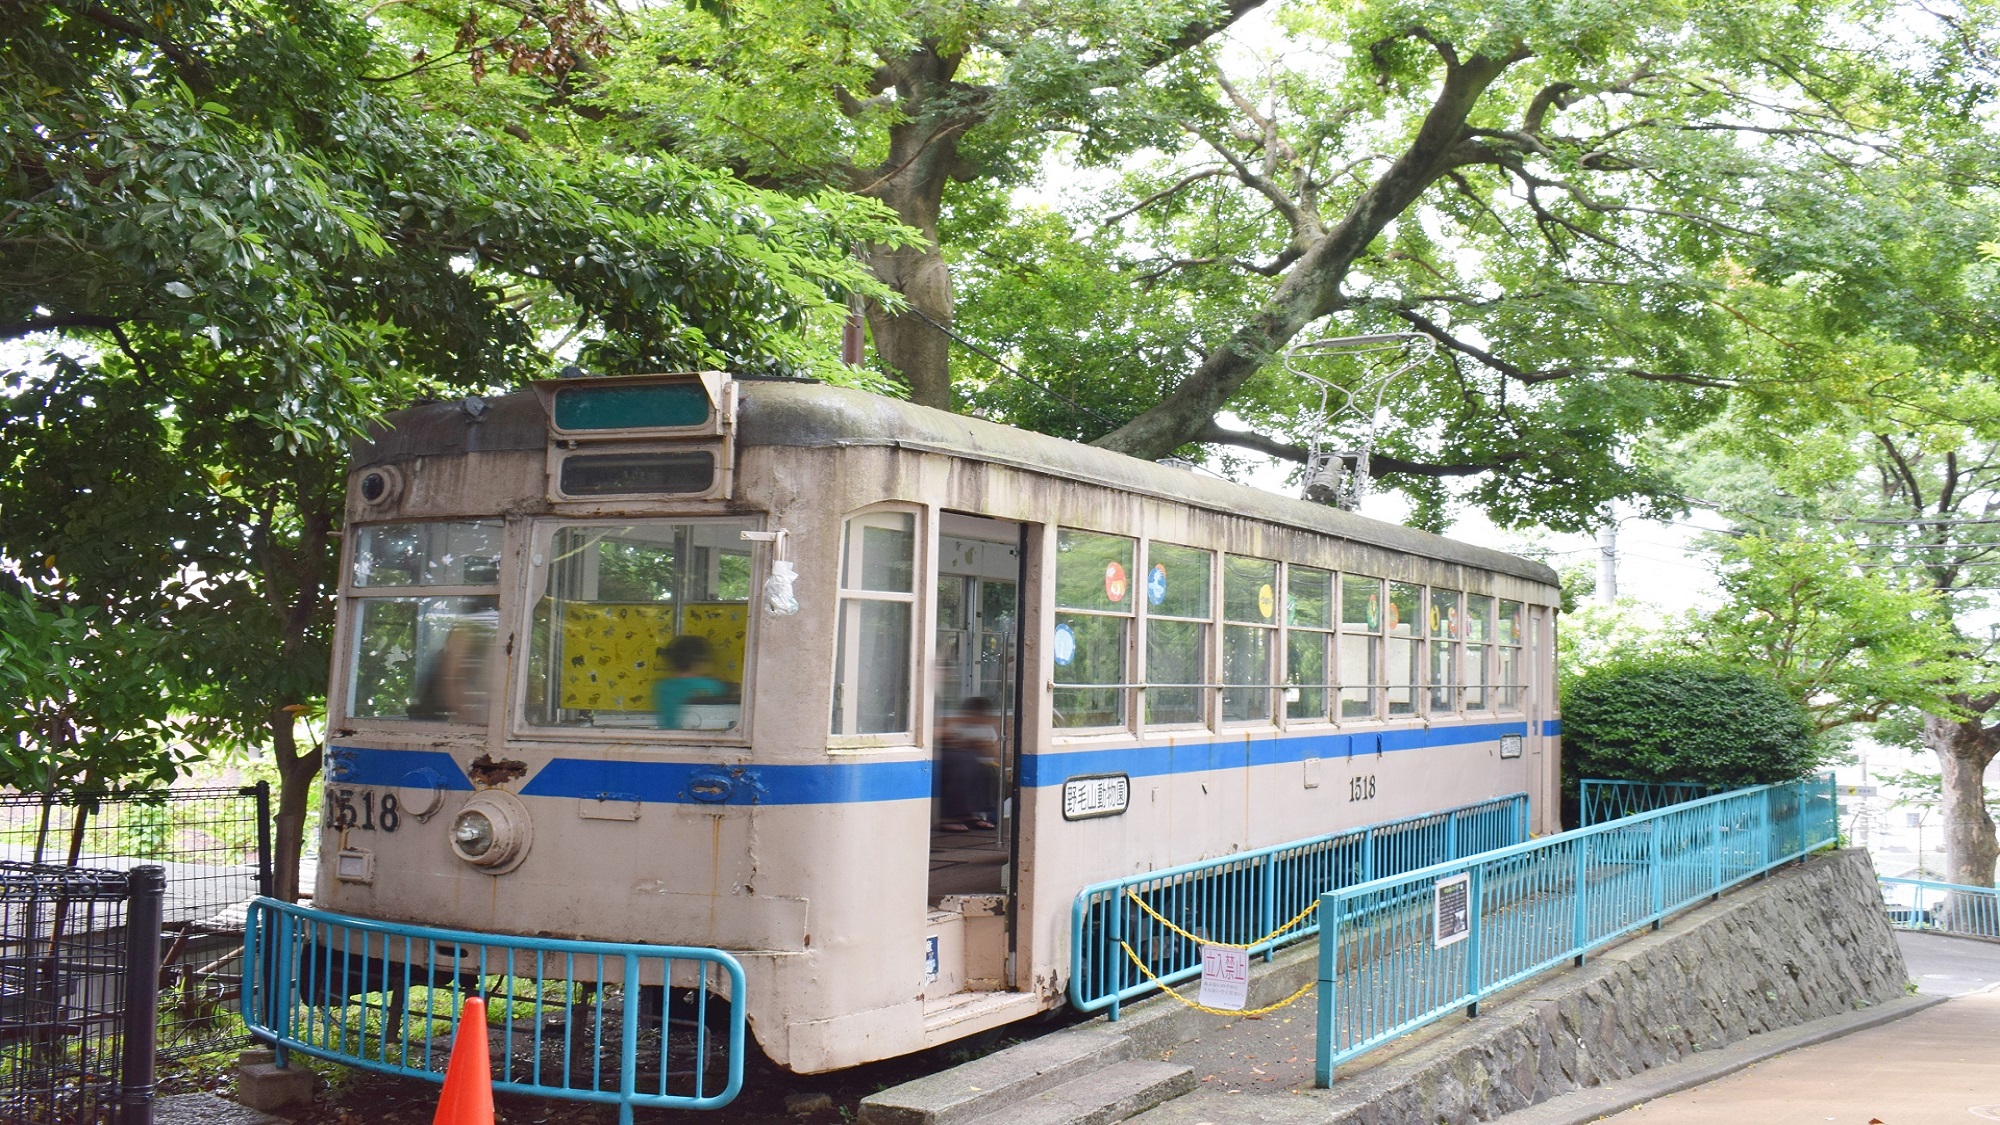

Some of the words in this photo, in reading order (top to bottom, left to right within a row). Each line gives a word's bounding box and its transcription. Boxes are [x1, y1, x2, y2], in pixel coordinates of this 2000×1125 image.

[1067, 781, 1125, 812] 野毛山動物園
[1349, 775, 1376, 802] 1518
[326, 788, 400, 832] 1518
[1206, 952, 1244, 980] 立入禁止
